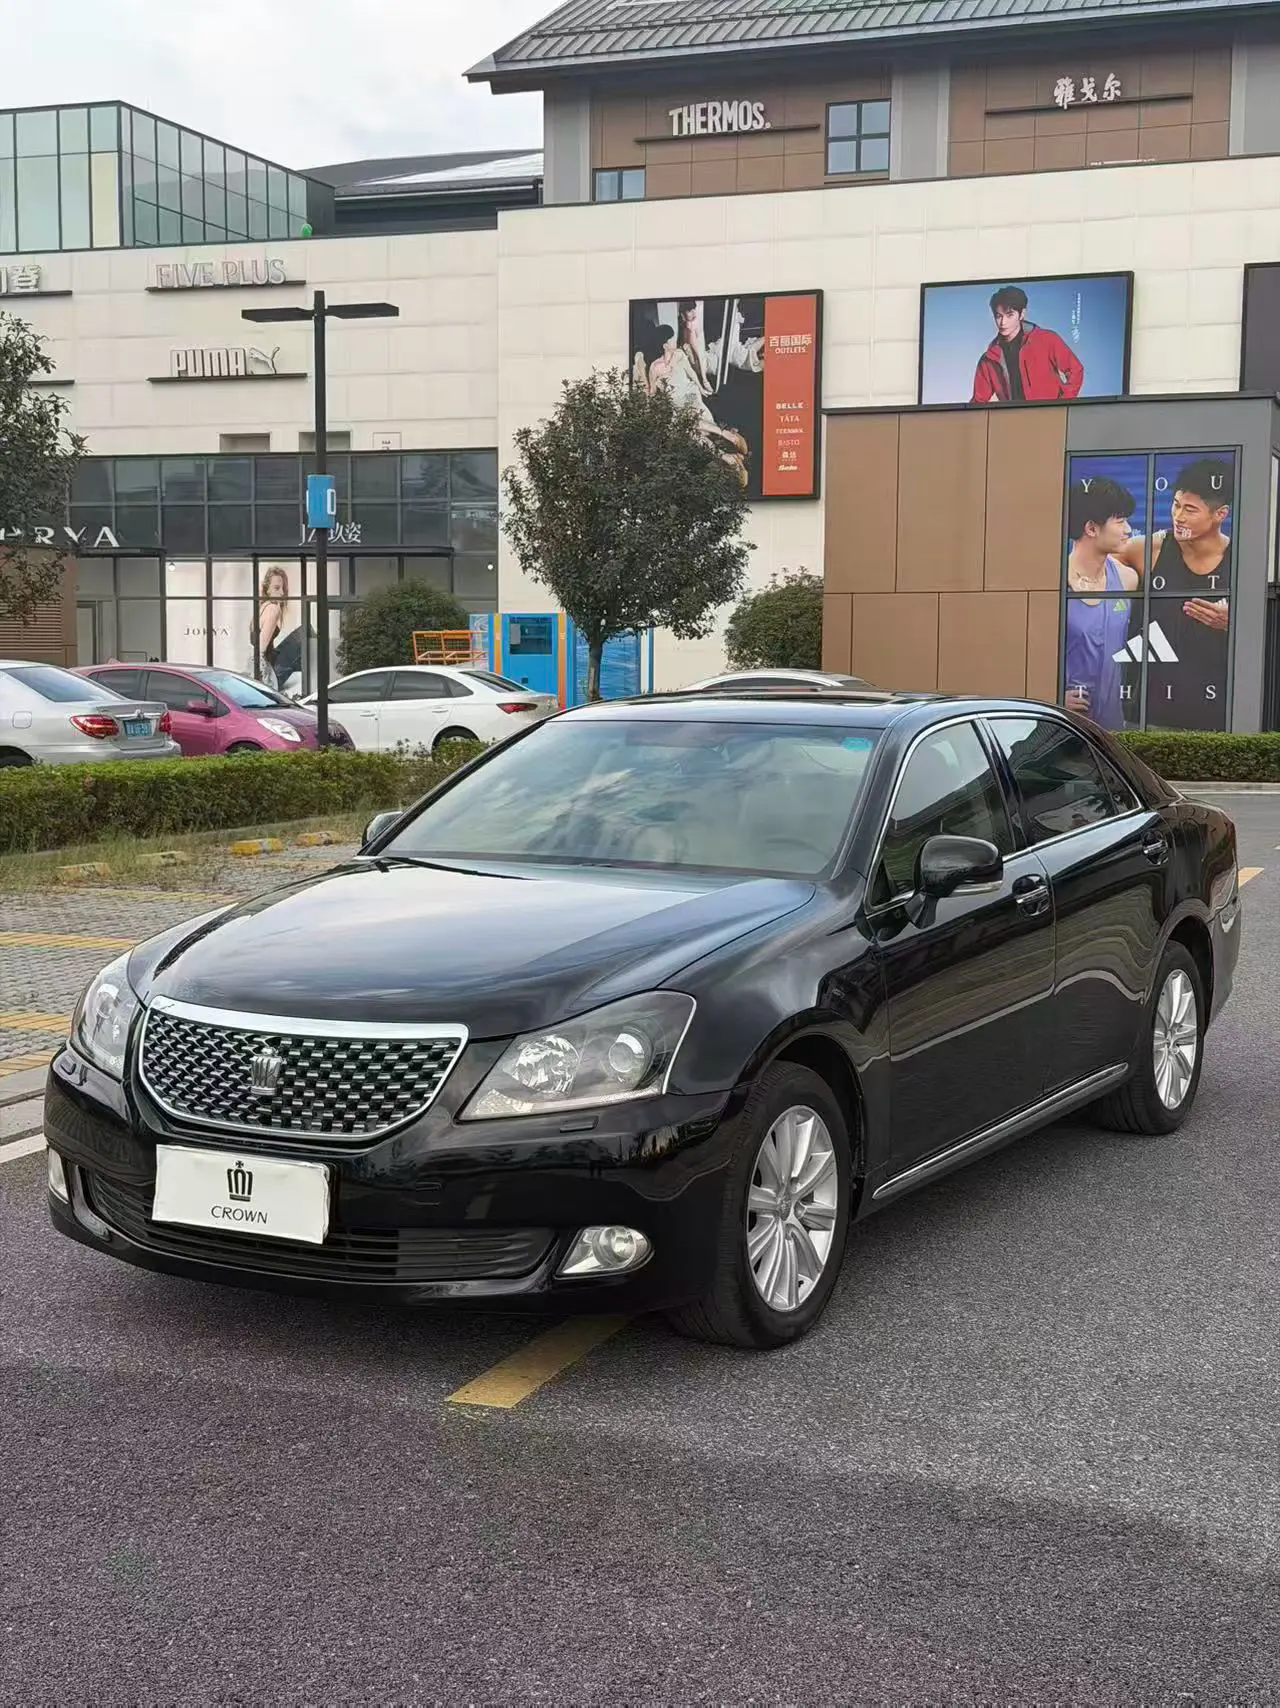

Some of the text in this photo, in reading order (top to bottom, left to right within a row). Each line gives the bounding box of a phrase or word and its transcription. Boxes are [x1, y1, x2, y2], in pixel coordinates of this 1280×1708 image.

[1053, 73, 1121, 110] 雅戈尔
[155, 259, 287, 288] FIVE PLUS
[170, 348, 247, 377] PUMA
[1081, 475, 1224, 493] YOU
[1075, 684, 1217, 700] THIS
[211, 1205, 268, 1225] CROWN
